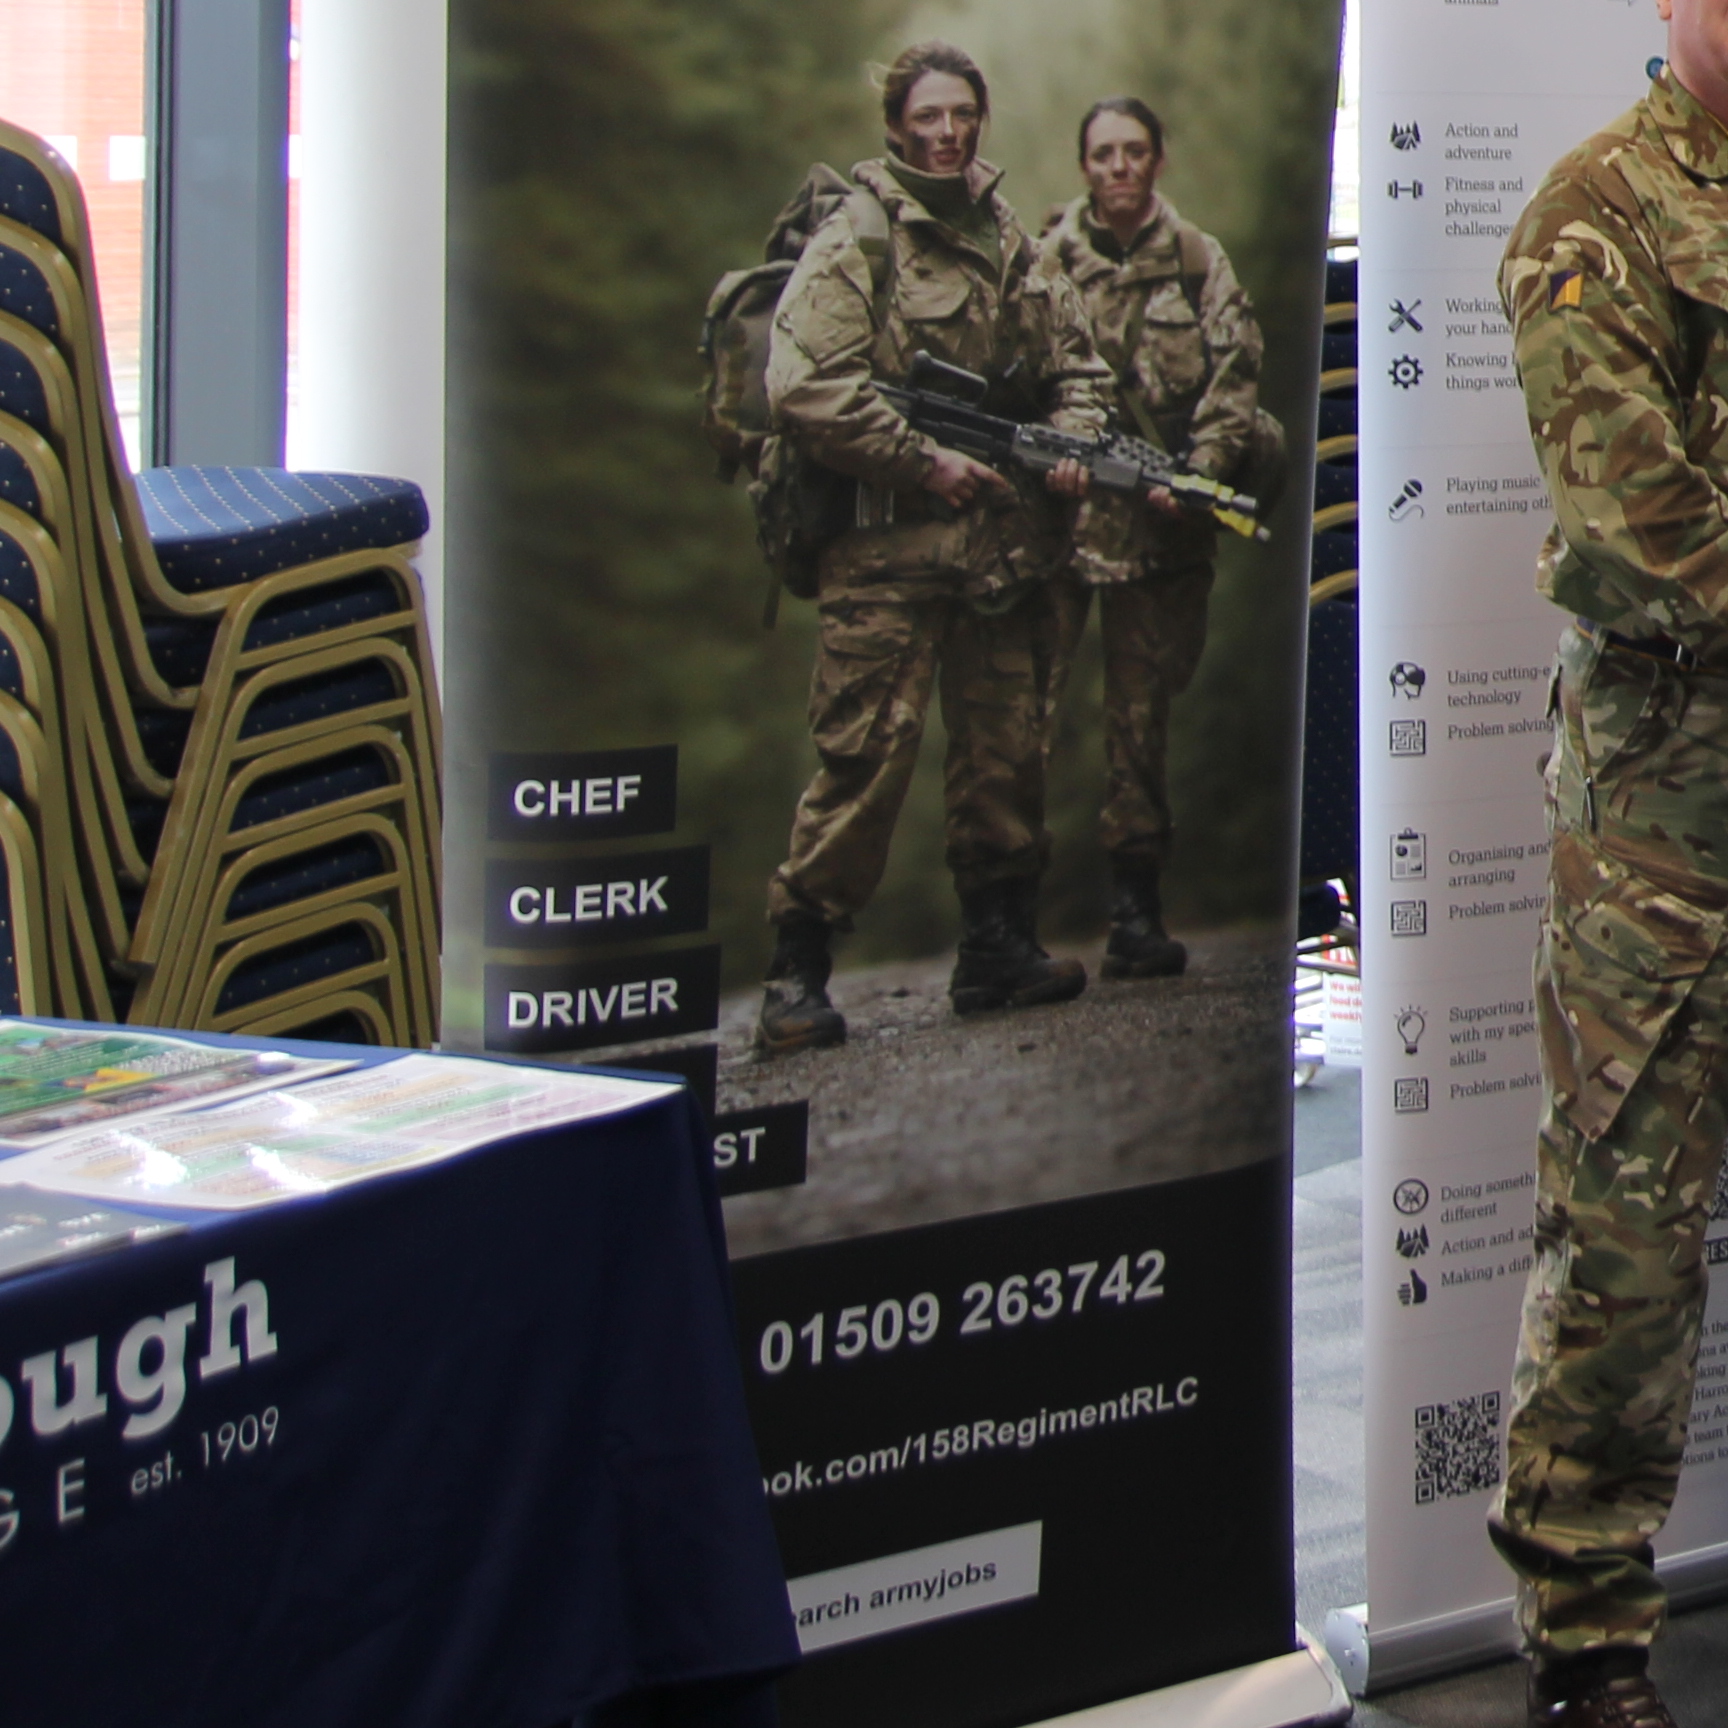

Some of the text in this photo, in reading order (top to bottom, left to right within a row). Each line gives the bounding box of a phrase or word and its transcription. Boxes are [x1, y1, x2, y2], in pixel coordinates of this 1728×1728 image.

[1445, 123, 1518, 138] Action and
[1445, 144, 1512, 160] adventure
[1445, 176, 1523, 191] Fitness and
[1445, 199, 1501, 216] physical
[1445, 353, 1507, 370] Knowing
[1445, 374, 1490, 391] things
[1446, 474, 1541, 494] Playing music
[1446, 495, 1537, 515] entertaining
[1447, 689, 1522, 708] technology
[513, 775, 642, 817] CHEF
[1449, 868, 1515, 888] arranging
[509, 876, 669, 924] CLERK
[1449, 902, 1505, 920] Problem
[507, 977, 679, 1030] DRIVER
[1449, 1002, 1524, 1023] Supporting
[1450, 1049, 1487, 1067] skills
[1450, 1079, 1505, 1099] Problem
[713, 1128, 766, 1169] ST
[1441, 1183, 1482, 1201] Doing
[1441, 1202, 1497, 1224] different
[760, 1249, 1166, 1374] 01509 263742
[762, 1377, 1199, 1497] ok.com/158RegimentRLC
[130, 1449, 183, 1495] est.
[200, 1406, 280, 1467] 1909
[869, 1559, 997, 1610] armyjobs
